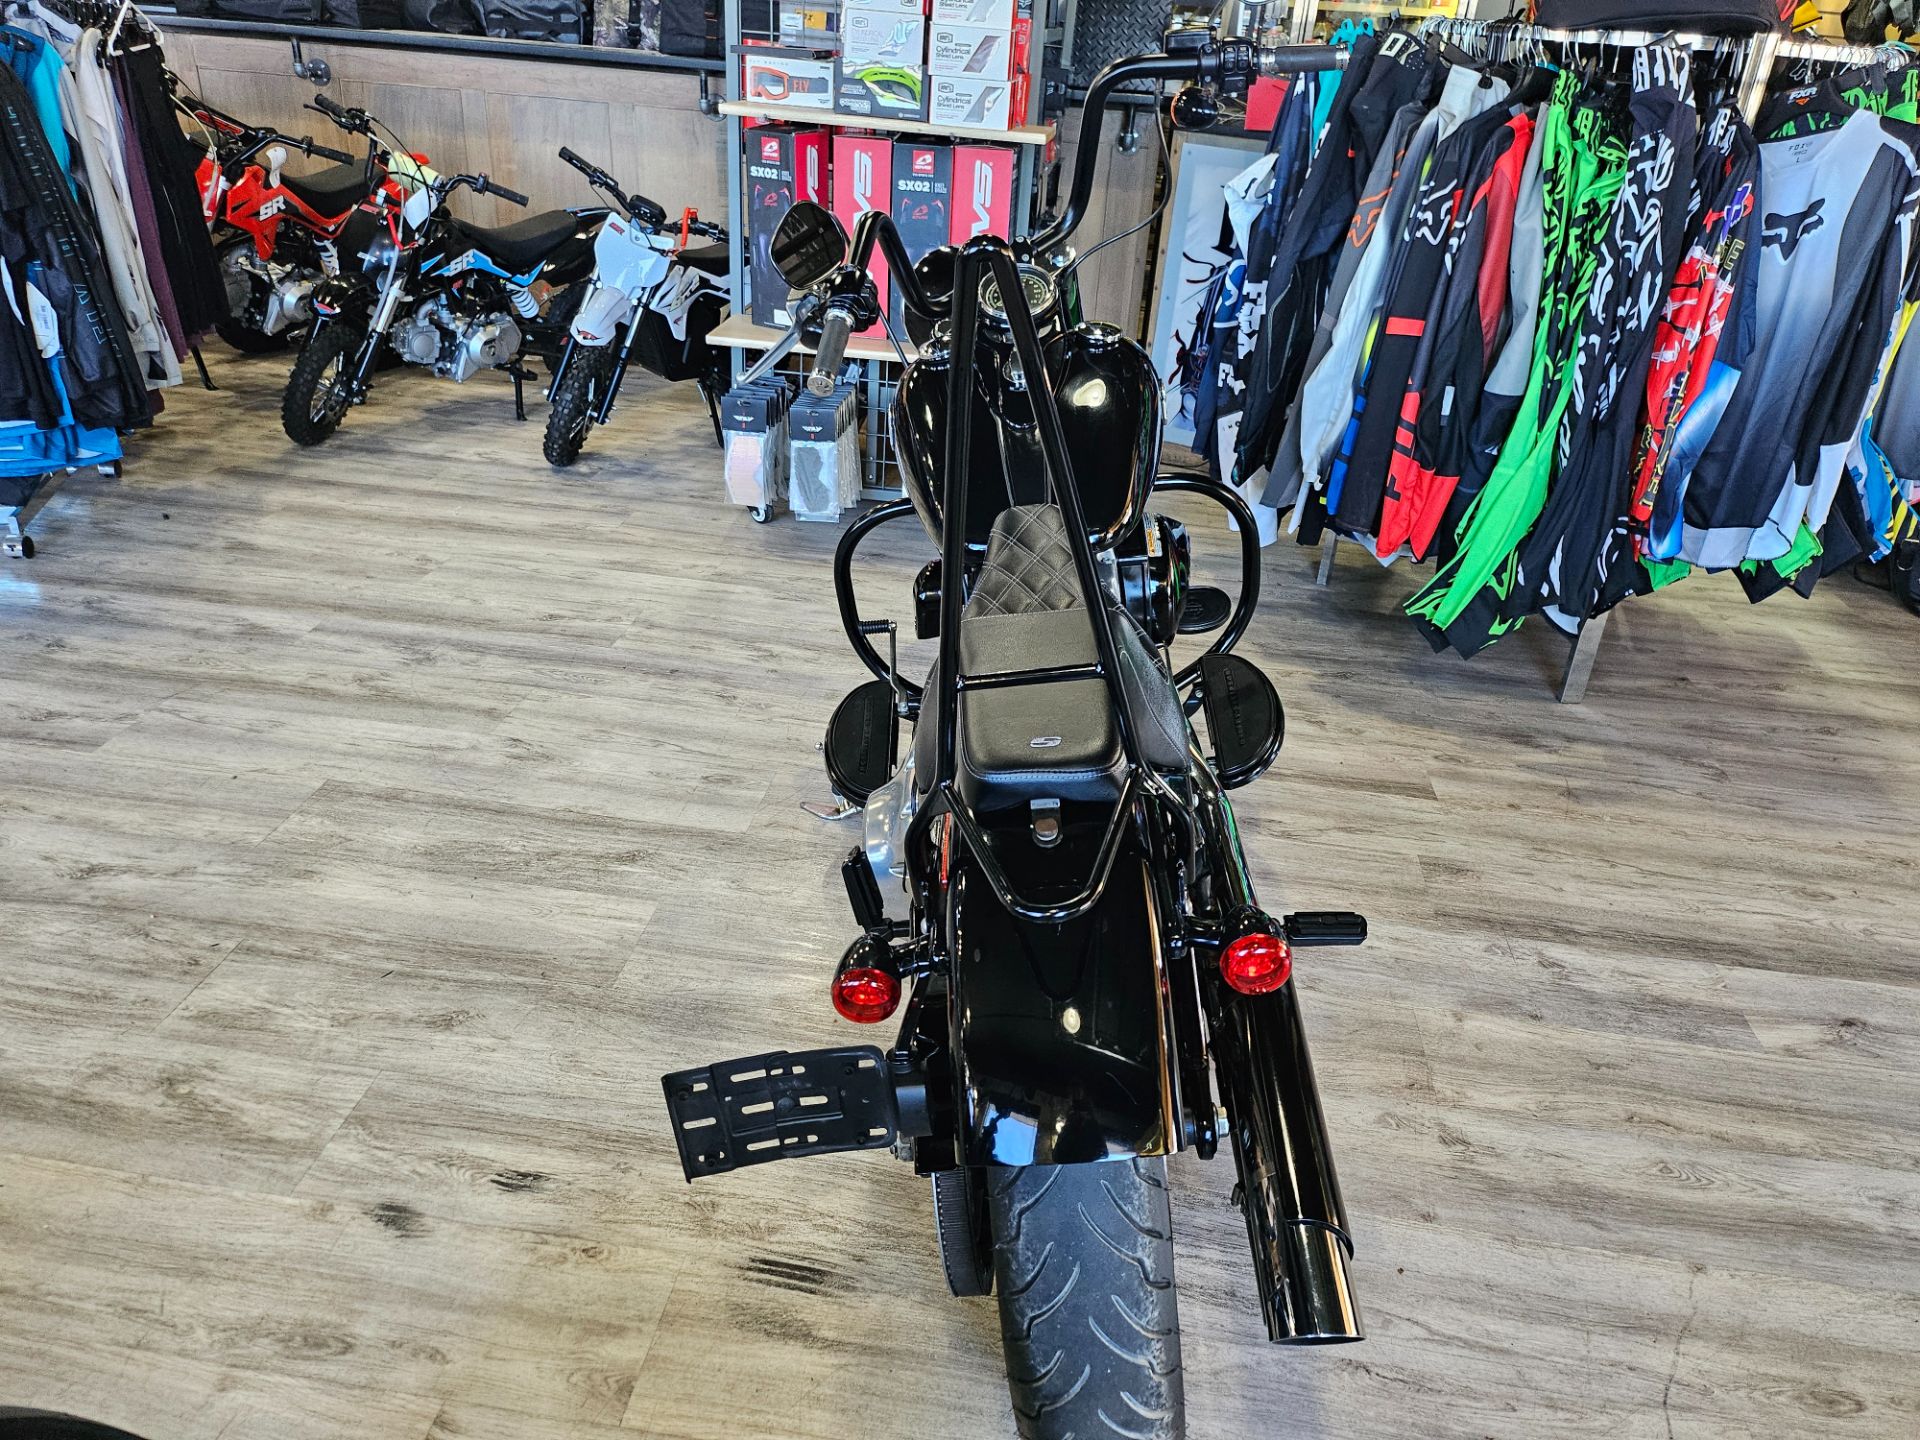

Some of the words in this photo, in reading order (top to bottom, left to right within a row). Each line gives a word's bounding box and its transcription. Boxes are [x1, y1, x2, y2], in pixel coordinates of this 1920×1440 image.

[936, 45, 971, 54] Cylindrical
[792, 79, 810, 93] FLY
[937, 95, 971, 104] Cylindrical
[1789, 87, 1817, 99] FXR
[750, 165, 778, 180] SX02
[898, 180, 930, 193] SX02
[259, 195, 287, 222] SR
[447, 250, 475, 276] SR
